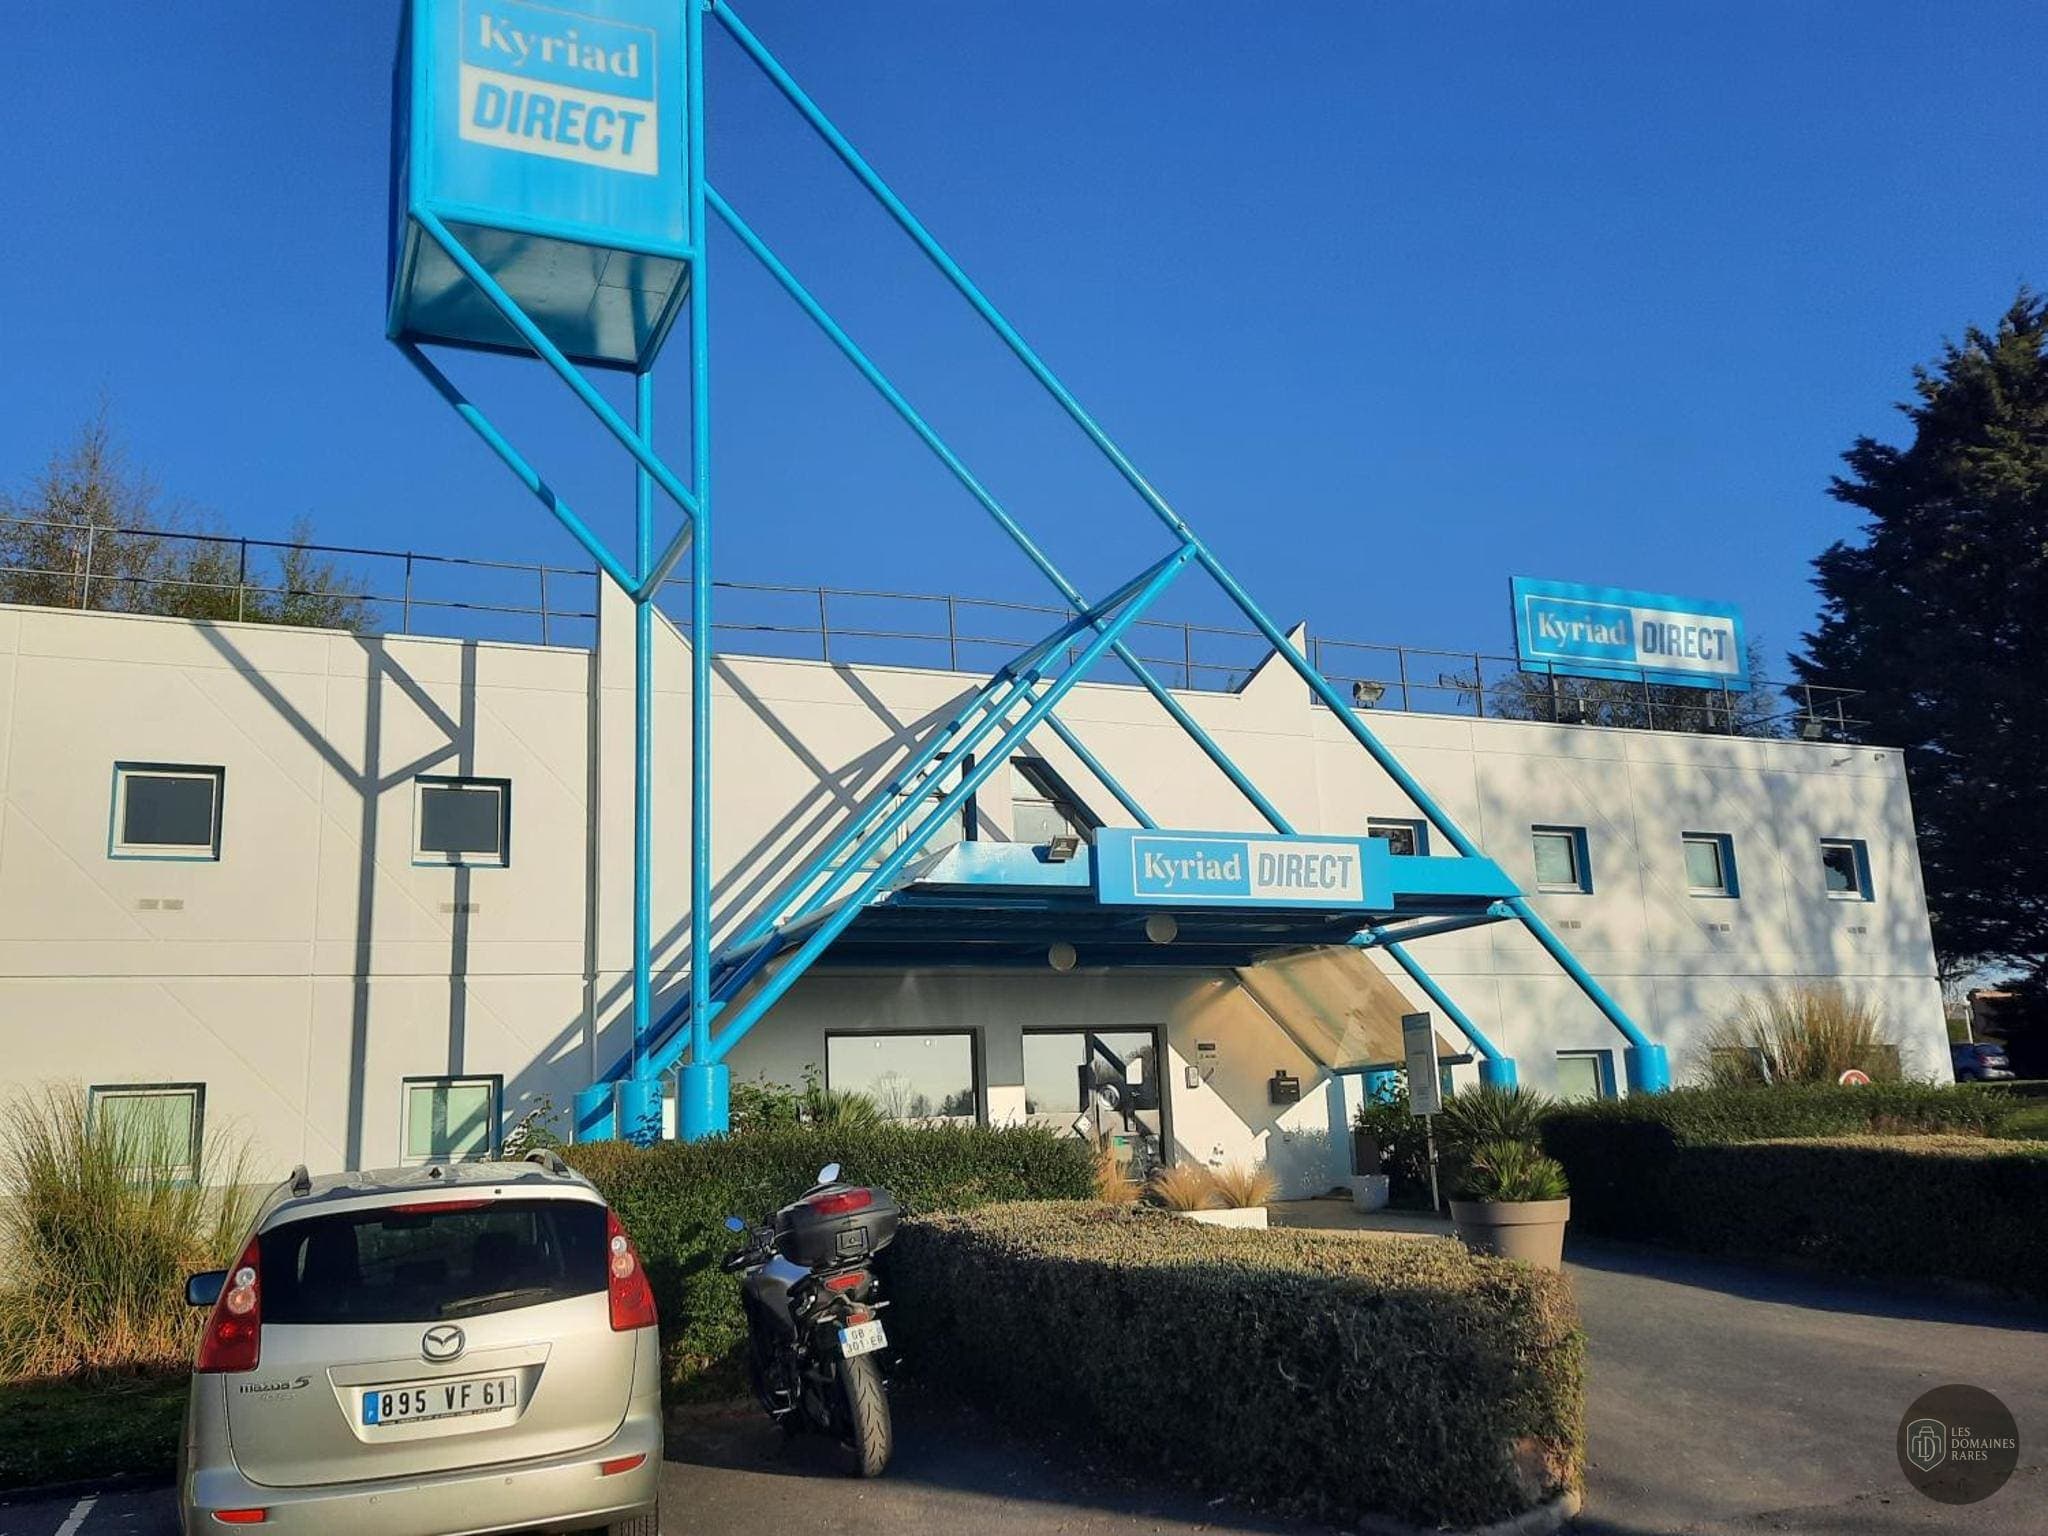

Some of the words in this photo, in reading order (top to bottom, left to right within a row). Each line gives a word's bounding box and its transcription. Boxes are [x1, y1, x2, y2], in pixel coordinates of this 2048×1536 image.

[480, 12, 640, 79] Kyriad
[472, 81, 646, 156] DIRECT
[1538, 611, 1628, 647] Kyriad
[1641, 620, 1728, 661] DIRECT
[1143, 851, 1242, 888] Kyriad
[1257, 852, 1354, 890] DIRECT
[382, 1389, 426, 1418] 895
[445, 1383, 472, 1410] VF
[483, 1380, 505, 1405] 61
